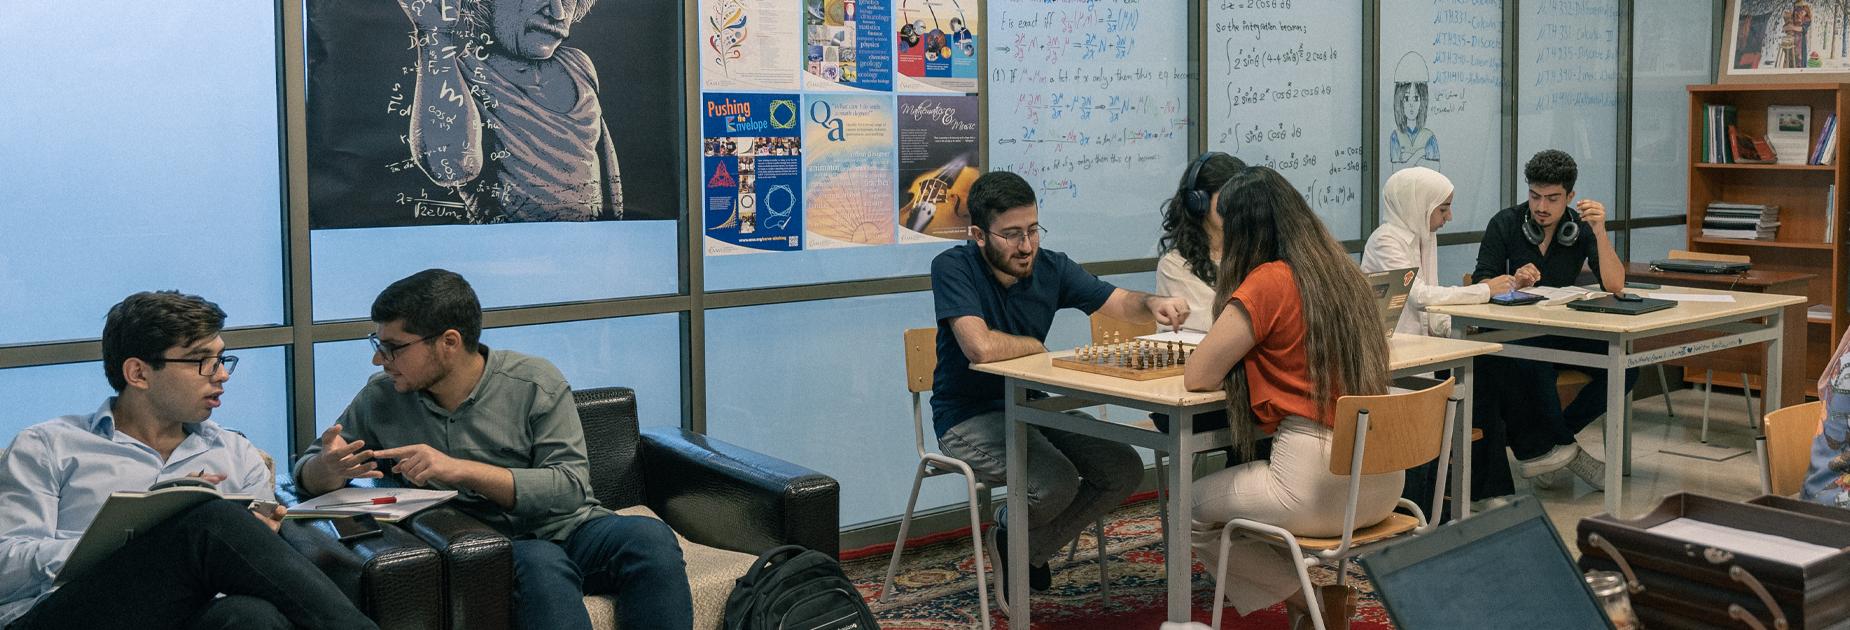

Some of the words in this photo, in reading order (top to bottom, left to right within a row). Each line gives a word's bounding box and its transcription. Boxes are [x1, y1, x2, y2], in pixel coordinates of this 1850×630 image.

[708, 98, 750, 118] Pushing
[901, 100, 944, 121] Mathematics
[726, 116, 768, 133] Envelope
[951, 119, 976, 130] Music
